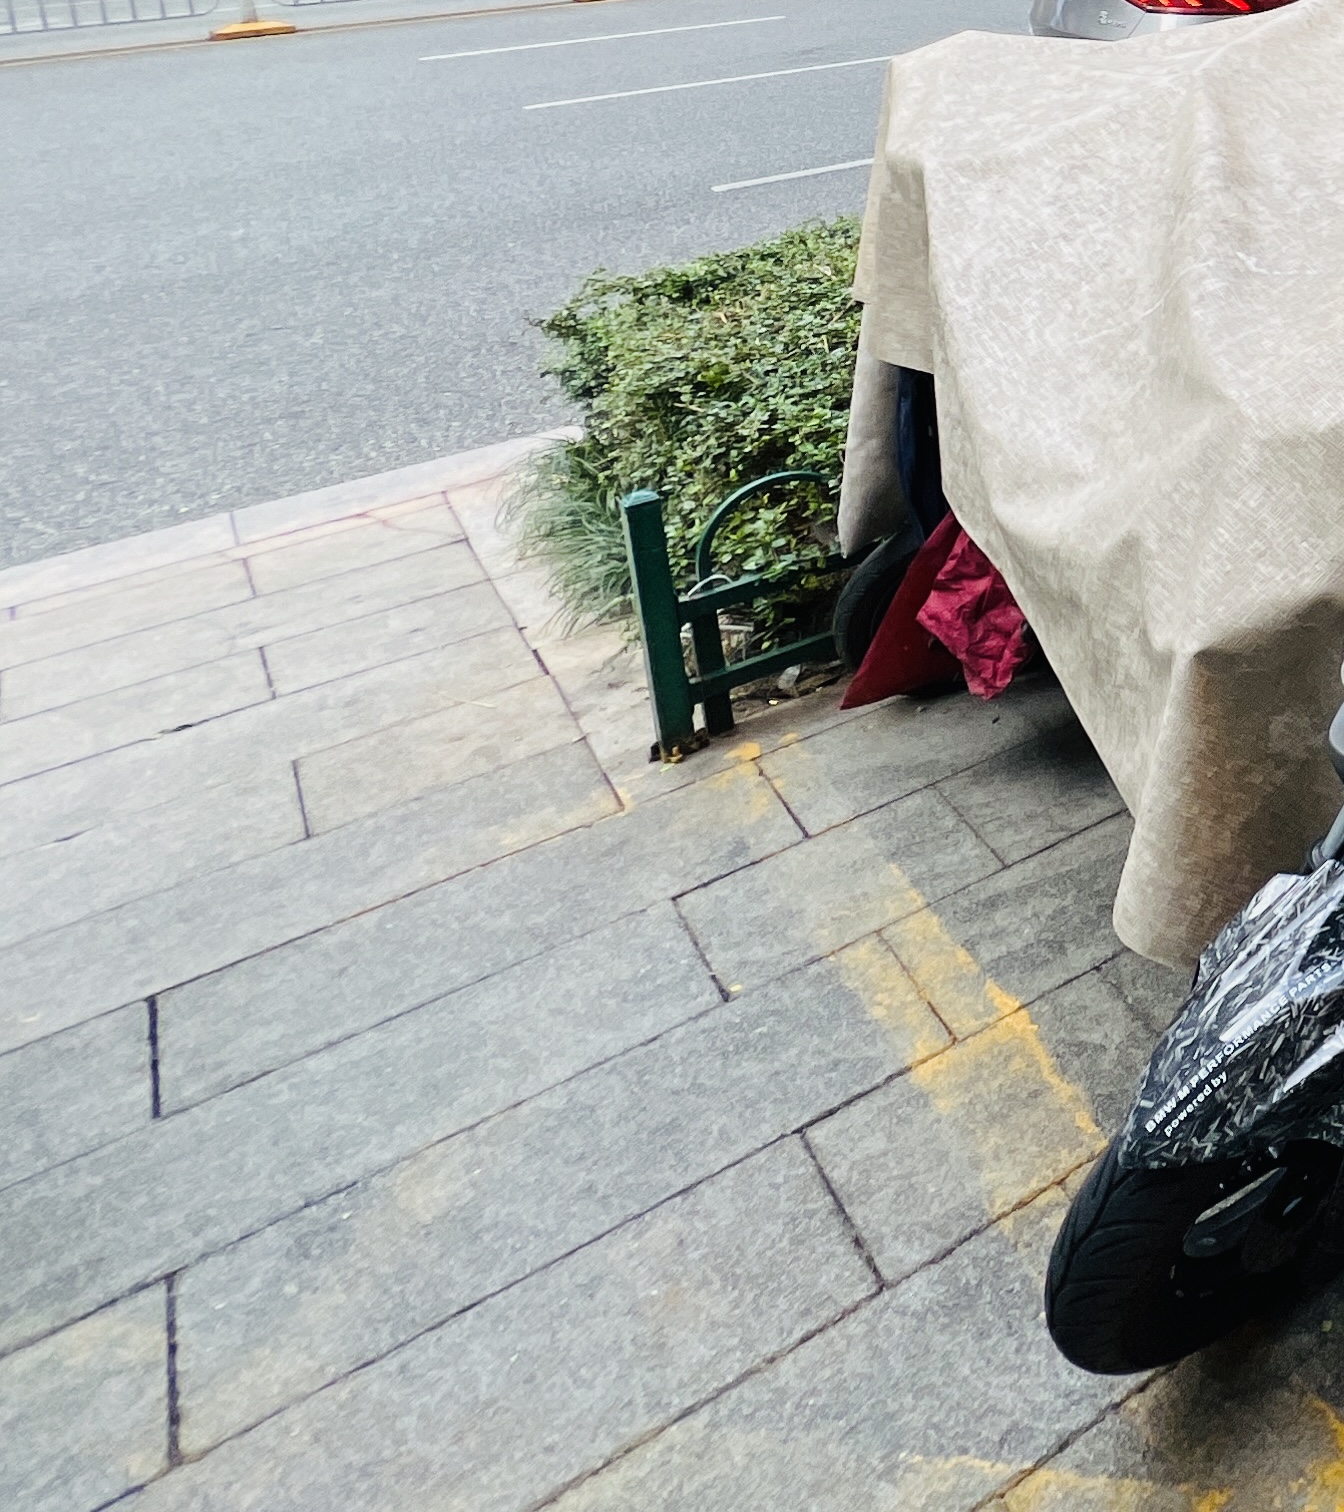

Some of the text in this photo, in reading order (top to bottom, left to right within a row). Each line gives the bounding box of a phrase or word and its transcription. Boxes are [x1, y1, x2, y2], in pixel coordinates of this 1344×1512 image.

[1145, 962, 1333, 1133] BMW M PERFORMANCE PARTS
[1164, 1071, 1228, 1137] powered by
